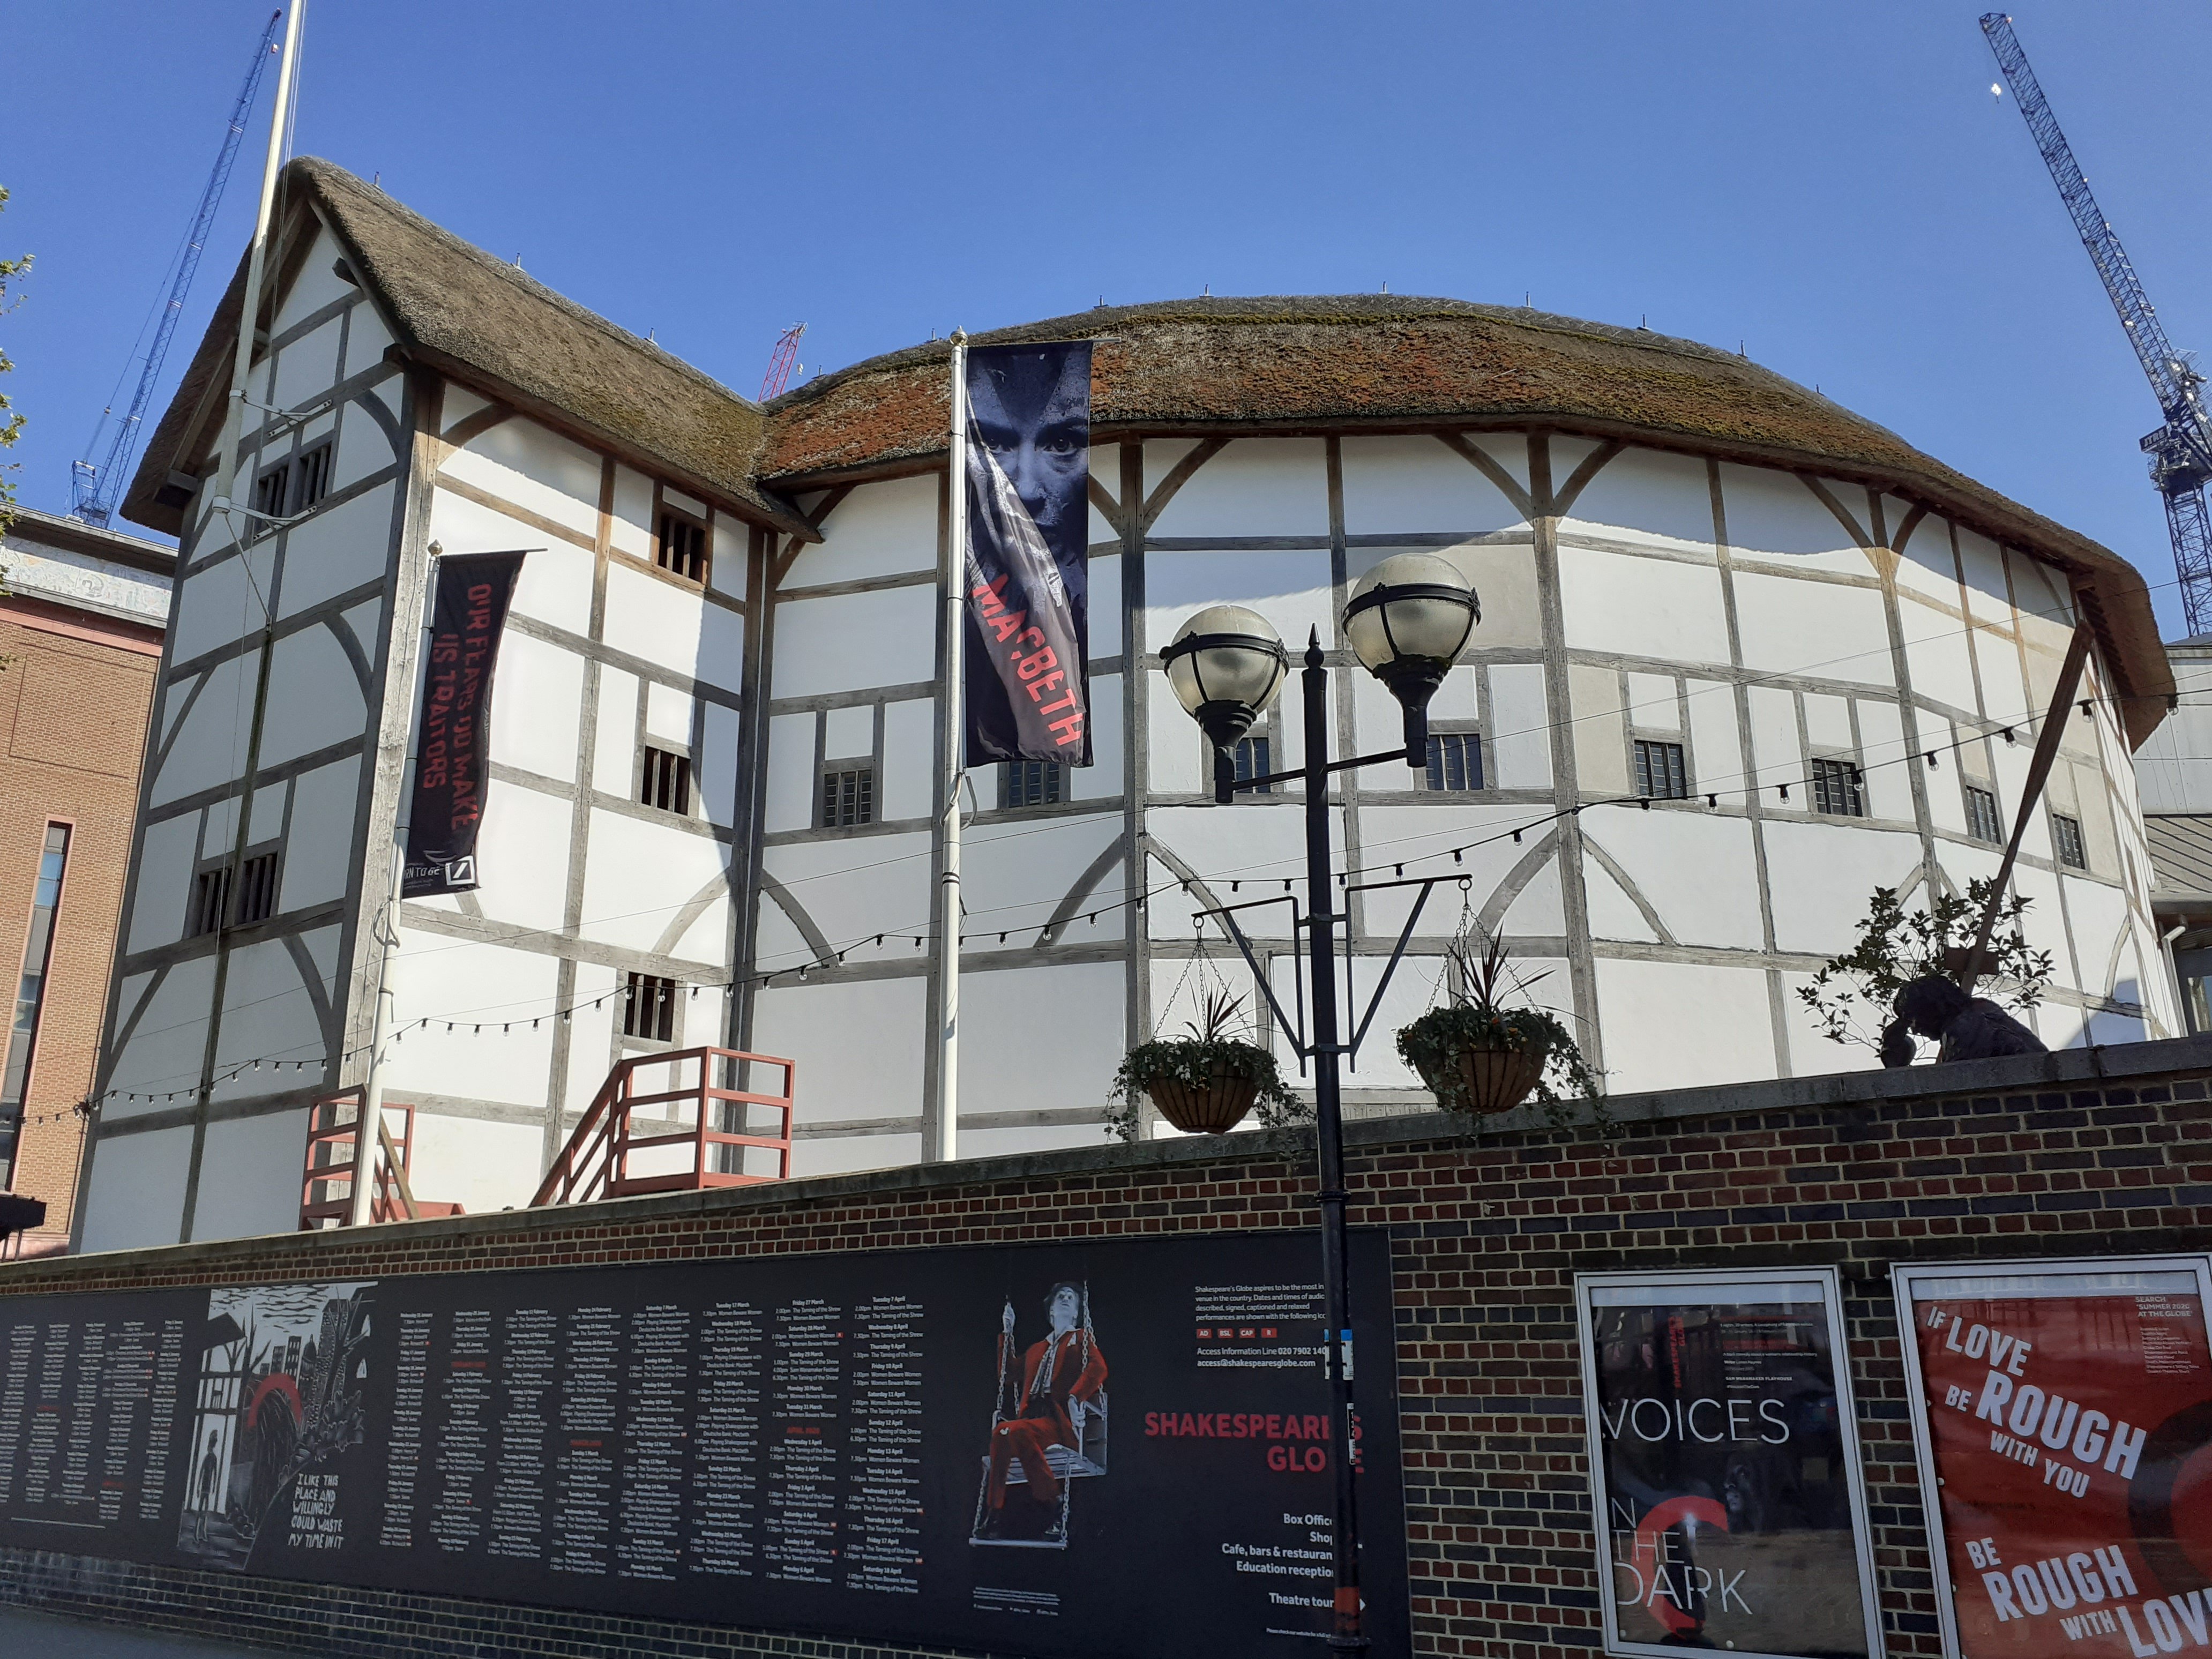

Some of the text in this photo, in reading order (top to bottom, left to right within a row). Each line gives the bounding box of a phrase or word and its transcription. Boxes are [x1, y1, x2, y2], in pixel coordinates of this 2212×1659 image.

[2144, 429, 2165, 447] JTRE
[466, 584, 491, 630] OUR
[972, 573, 1083, 746] MACBETH
[457, 636, 490, 711] FEARS
[423, 634, 459, 788] US TRAITORS
[451, 753, 478, 830] MAKE
[1225, 1304, 1246, 1312] signed,
[1246, 1303, 1275, 1311] captioned
[1230, 1295, 1253, 1303] country.
[1196, 1314, 1235, 1322] performances
[1290, 1312, 1317, 1321] following
[1927, 1306, 1946, 1329] IF
[1197, 1347, 1221, 1355] Access
[1221, 1347, 1261, 1355] Information
[1946, 1316, 2031, 1377] LOVE
[1197, 1359, 1316, 1369] access@shakespearesglobe.com
[1145, 1412, 1362, 1441] SHAKESPEARS
[1600, 1398, 1789, 1444] VOICES
[1945, 1370, 2147, 1479] BE ROUGH
[1267, 1446, 1364, 1473] GLOE
[1990, 1430, 2090, 1498] WITH YOU
[295, 1486, 336, 1502] PLACE AND
[304, 1474, 320, 1487] LIKE
[323, 1474, 339, 1486] THIS
[293, 1500, 334, 1516] WILLINGLY
[1283, 1513, 1303, 1525] Box
[1611, 1497, 1636, 1528] N
[291, 1515, 343, 1533] COULD WASTE
[288, 1533, 344, 1549] MY TIME IN IT
[1222, 1543, 1333, 1560] Cafe, bars & restauran
[1612, 1529, 1684, 1564] THE
[1966, 1537, 2001, 1569] BE
[1236, 1560, 1287, 1574] Education
[1613, 1561, 1753, 1615] DARK
[1982, 1545, 2139, 1622] ROUGH
[1268, 1592, 1334, 1608] Theatre tour
[2059, 1610, 2118, 1640] WITH
